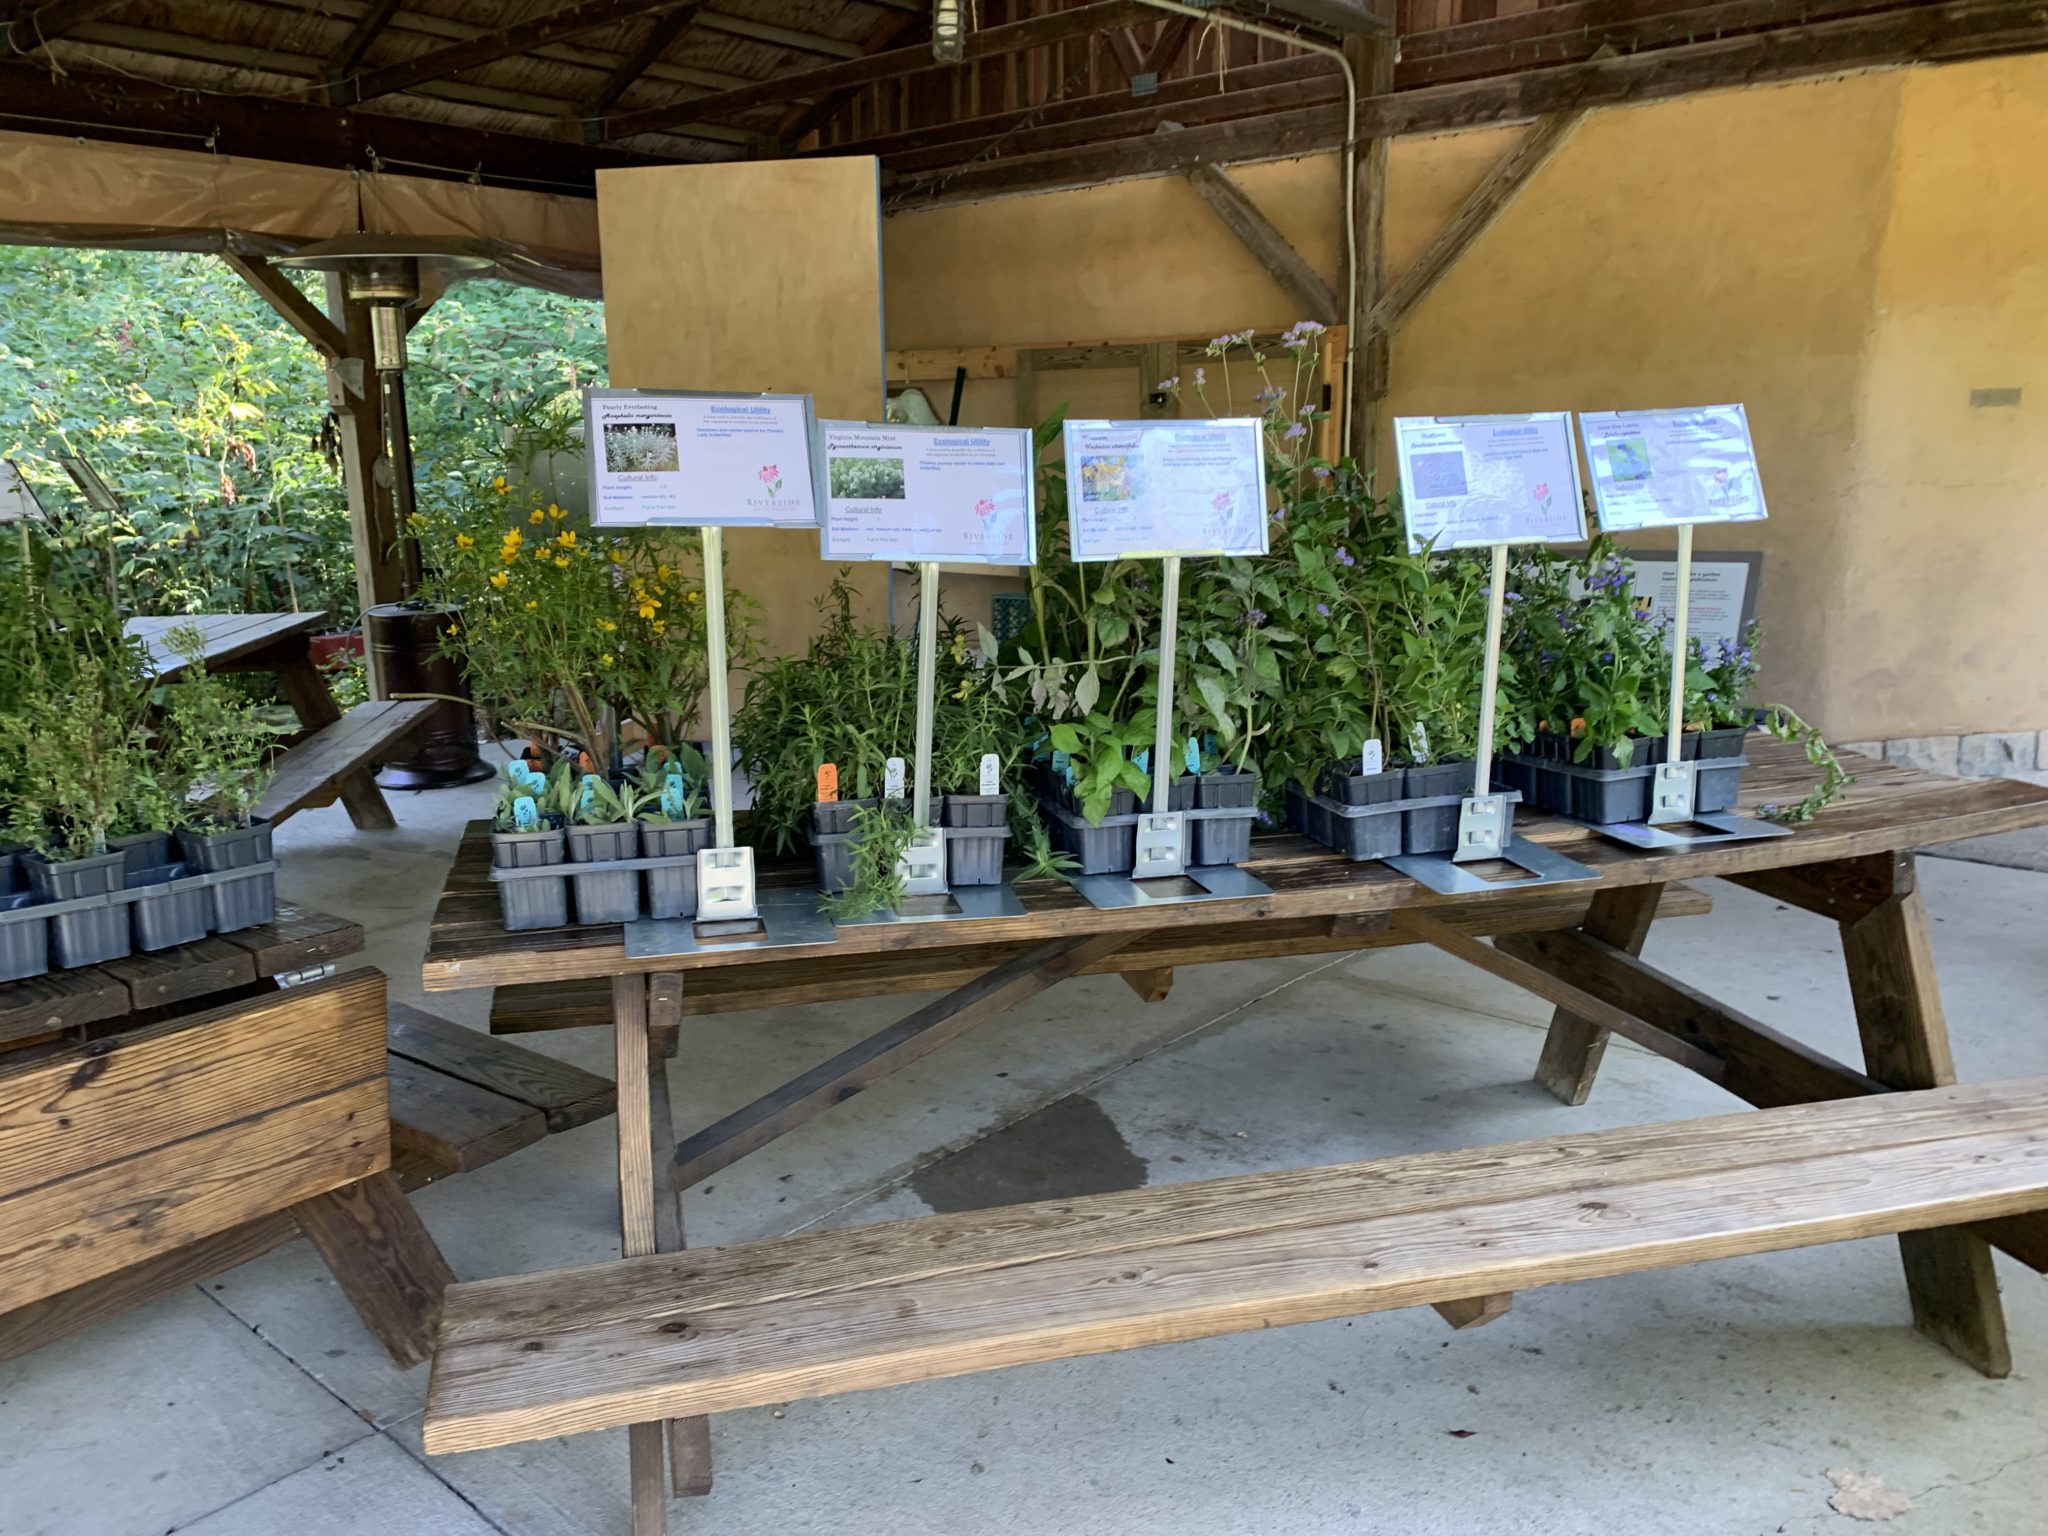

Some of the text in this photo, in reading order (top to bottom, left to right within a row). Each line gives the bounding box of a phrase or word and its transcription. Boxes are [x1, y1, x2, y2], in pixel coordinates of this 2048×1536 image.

[624, 404, 658, 412] Everlasting
[710, 405, 771, 415] Ecological Utility
[933, 437, 991, 446] Ecological Utility
[618, 474, 658, 482] Cultural Info
[845, 506, 882, 514] Cultural Info
